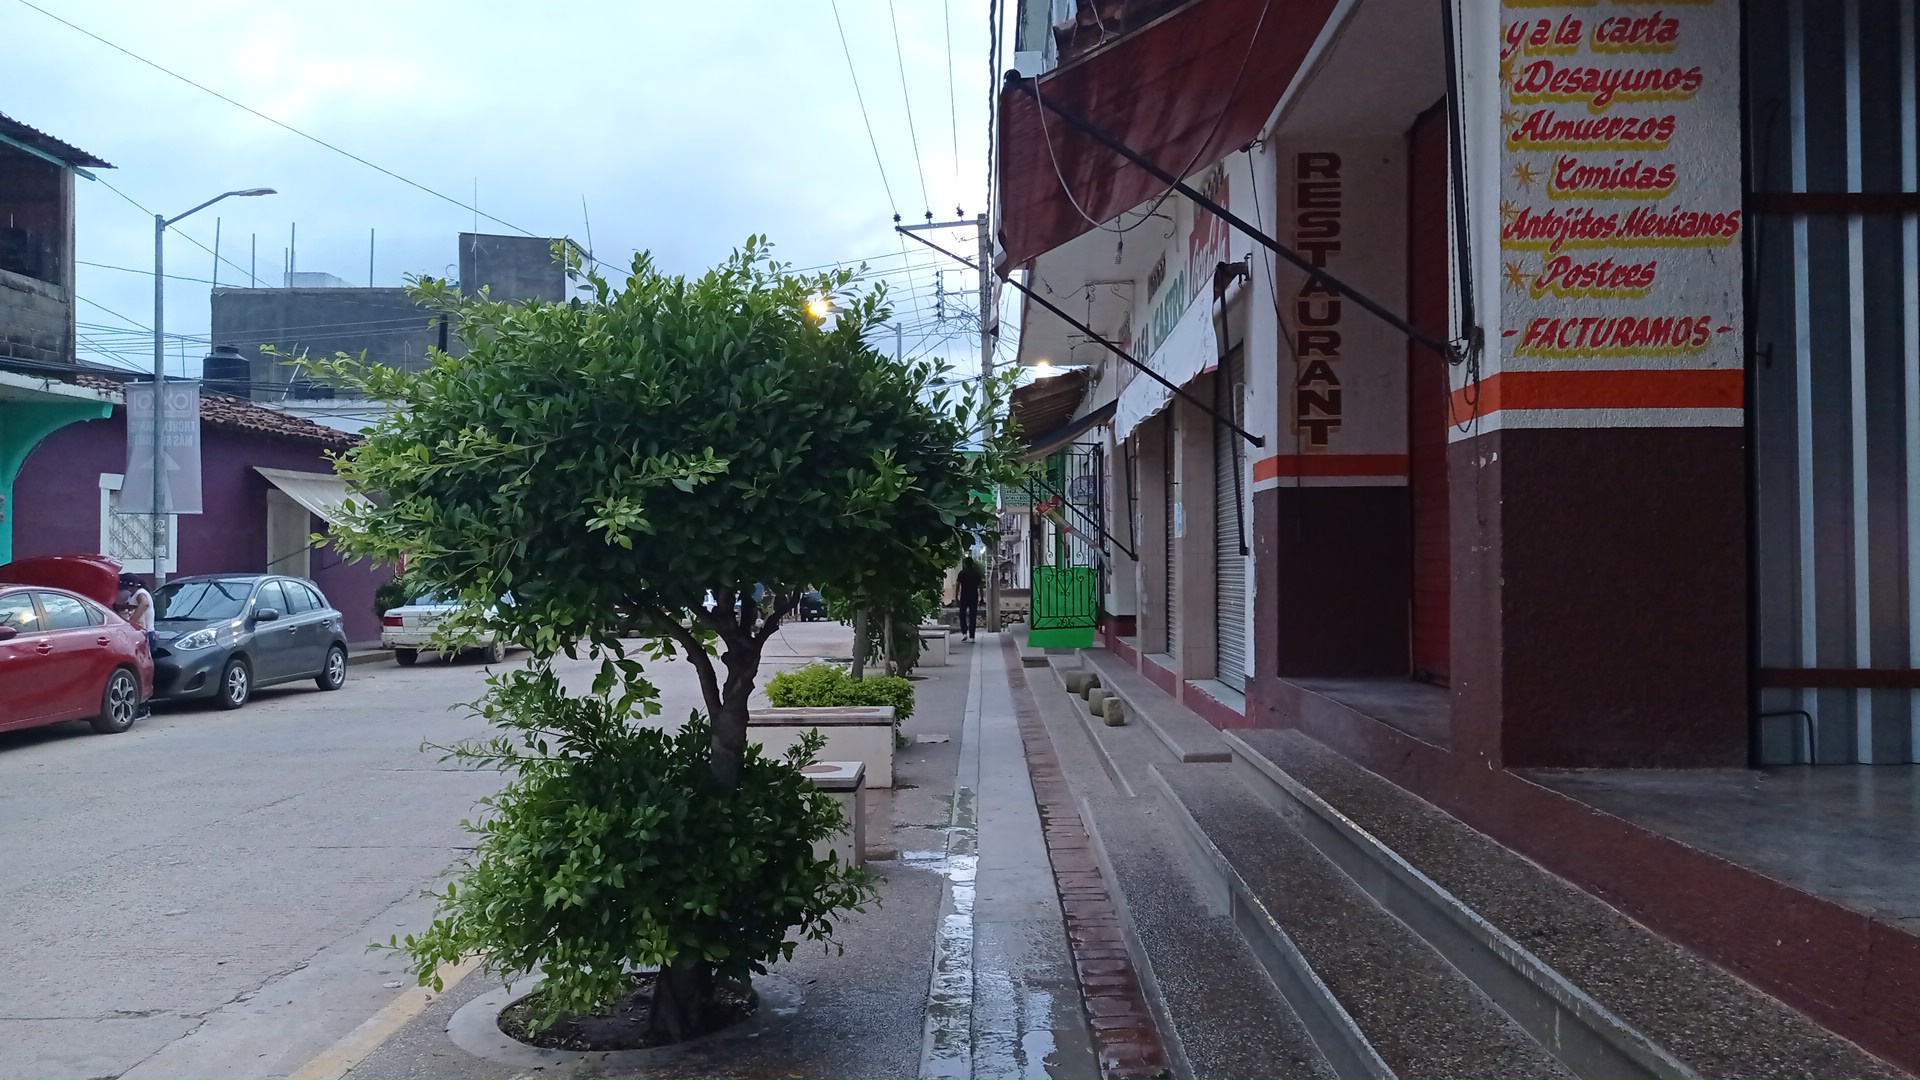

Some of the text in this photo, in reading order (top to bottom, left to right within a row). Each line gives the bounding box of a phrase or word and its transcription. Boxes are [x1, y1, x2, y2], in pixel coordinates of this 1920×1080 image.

[1500, 10, 1680, 58] y a la carta
[1514, 59, 1703, 106] Desayunos
[1512, 109, 1676, 142] Almuerzos
[1555, 154, 1677, 190] Comidas
[1504, 205, 1741, 252] Antojitos Mexicanos
[1536, 255, 1658, 289] Postres
[1153, 270, 1185, 350] CASTRO
[1297, 152, 1342, 445] RESTAURANT
